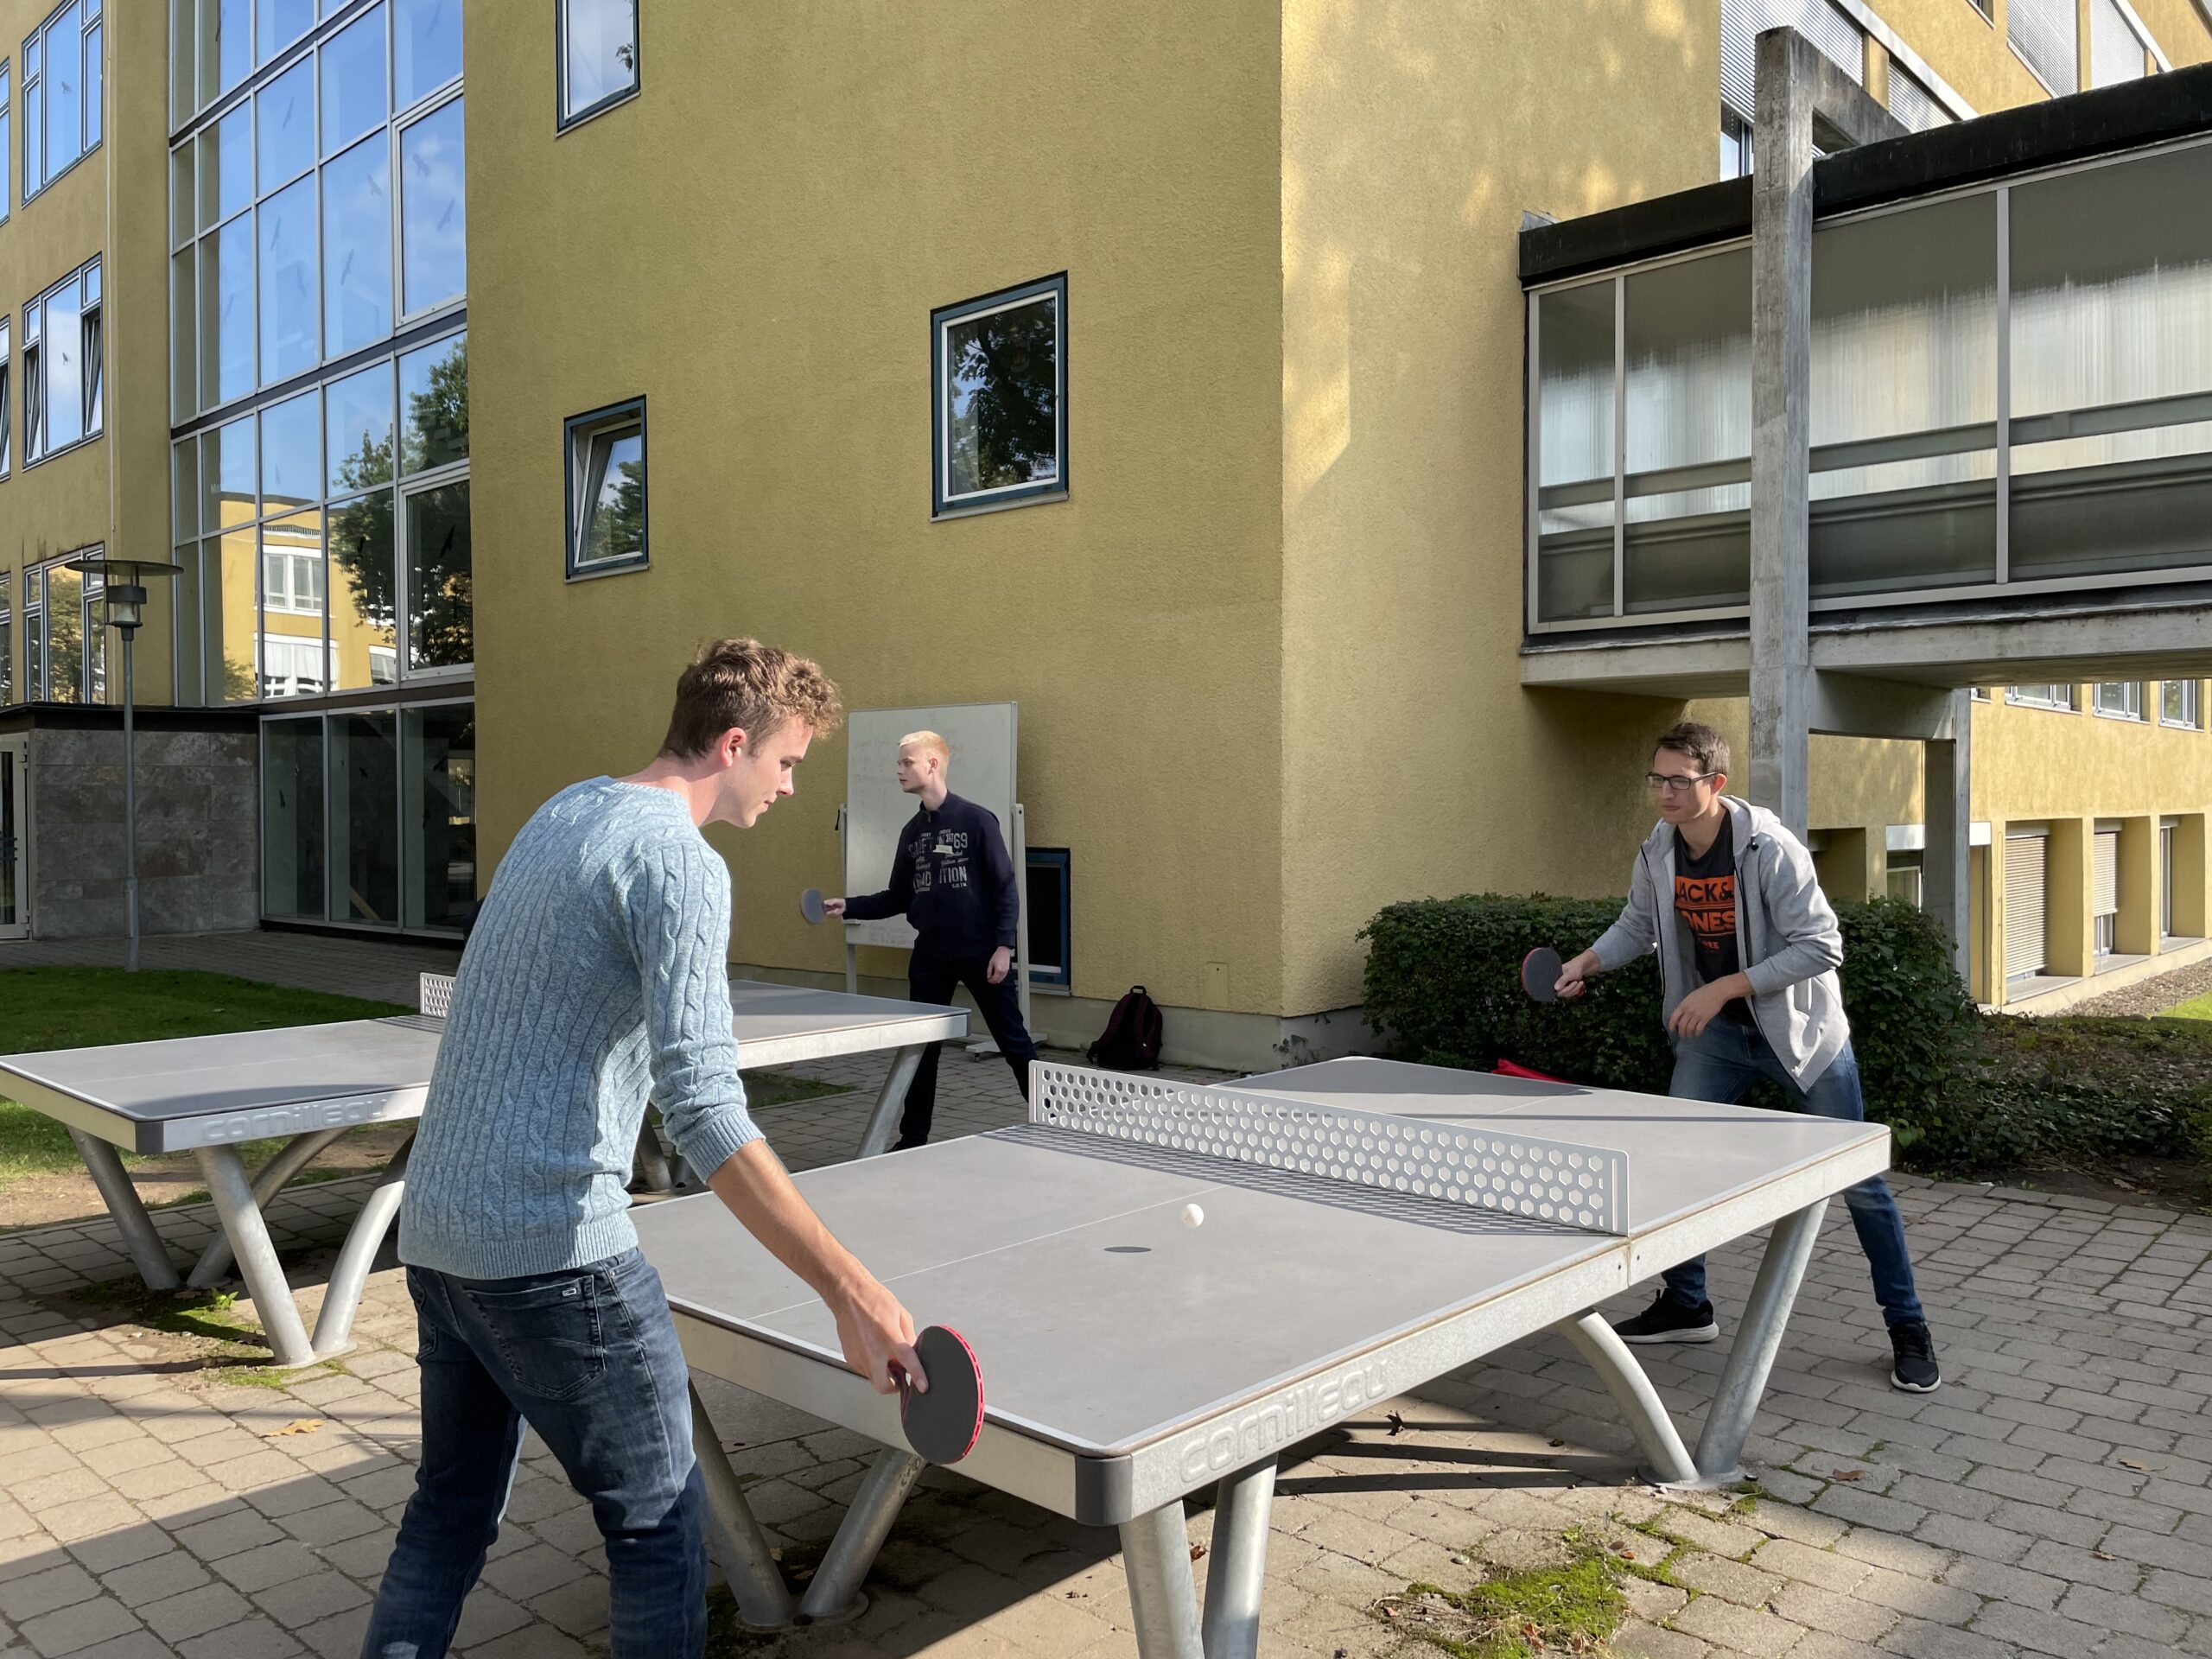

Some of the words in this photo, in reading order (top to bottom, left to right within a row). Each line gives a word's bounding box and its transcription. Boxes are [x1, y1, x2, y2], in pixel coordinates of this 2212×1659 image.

[953, 832, 968, 849] 69
[205, 1099, 388, 1141] cornilleau
[1181, 1360, 1388, 1483] cornilleau
